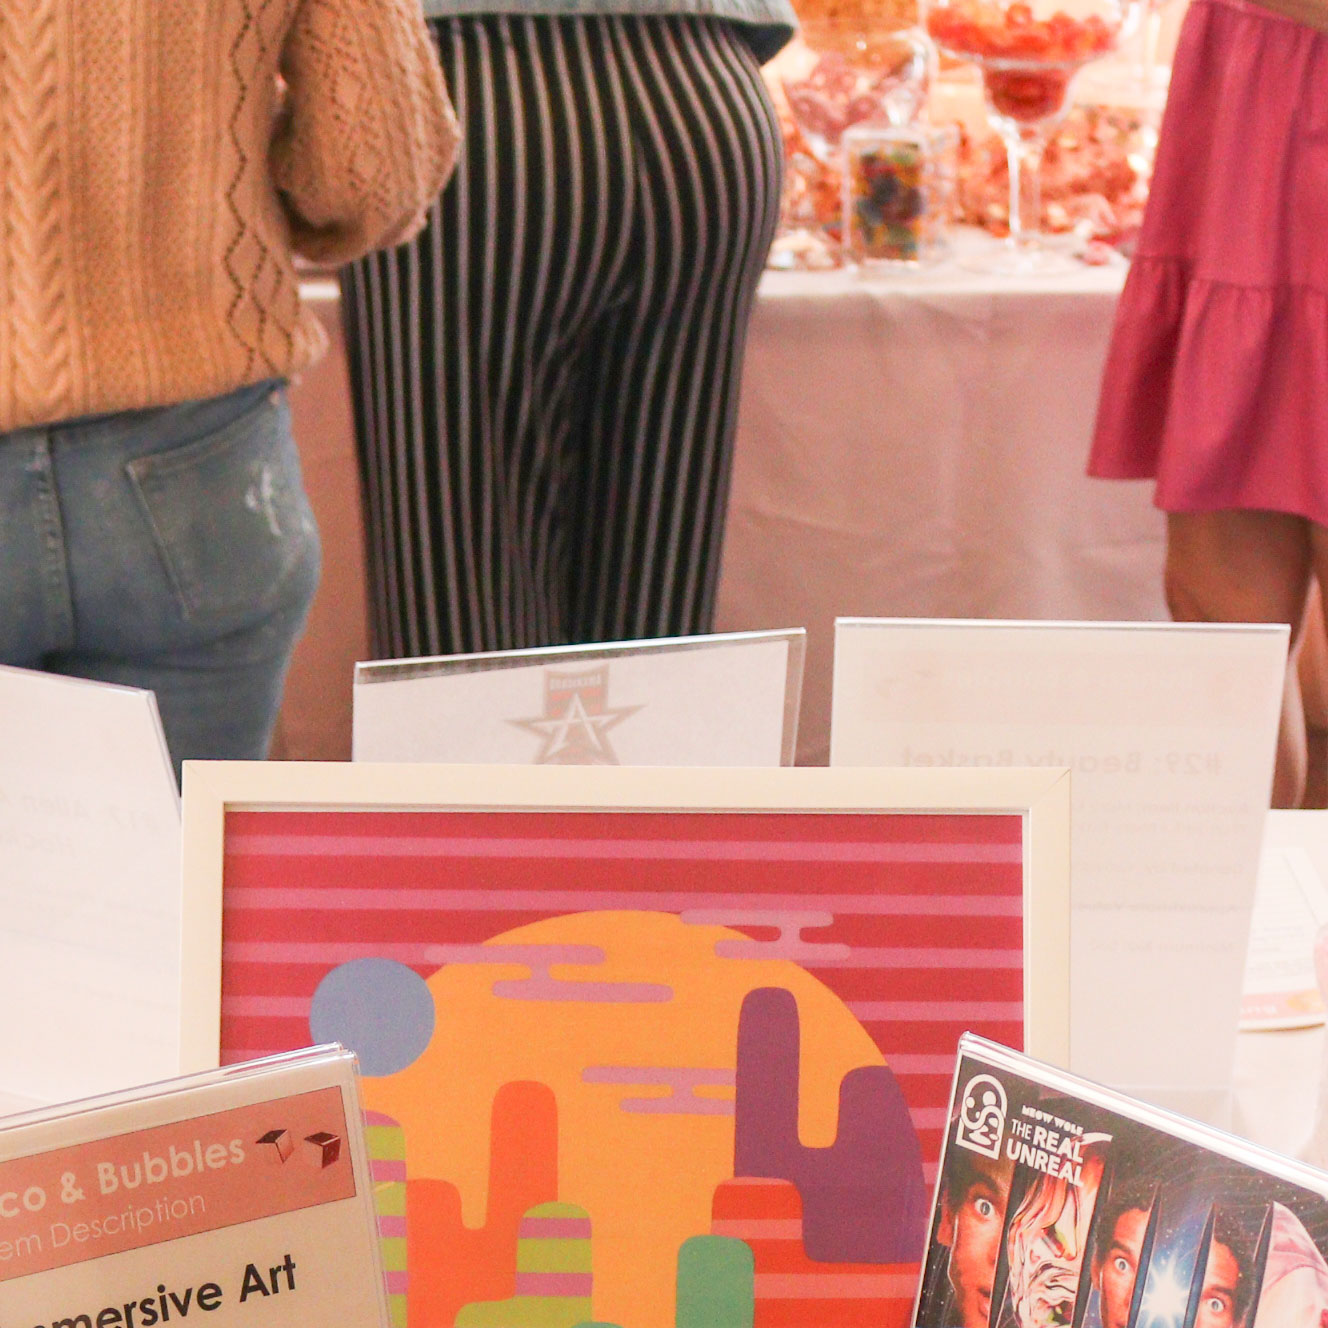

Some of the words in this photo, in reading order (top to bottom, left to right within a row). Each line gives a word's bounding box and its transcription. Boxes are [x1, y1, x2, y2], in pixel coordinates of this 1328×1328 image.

[1007, 1138, 1084, 1187] UNREAL
[1012, 1119, 1032, 1140] THE
[1033, 1126, 1083, 1163] REAL
[238, 1253, 296, 1303] Art
